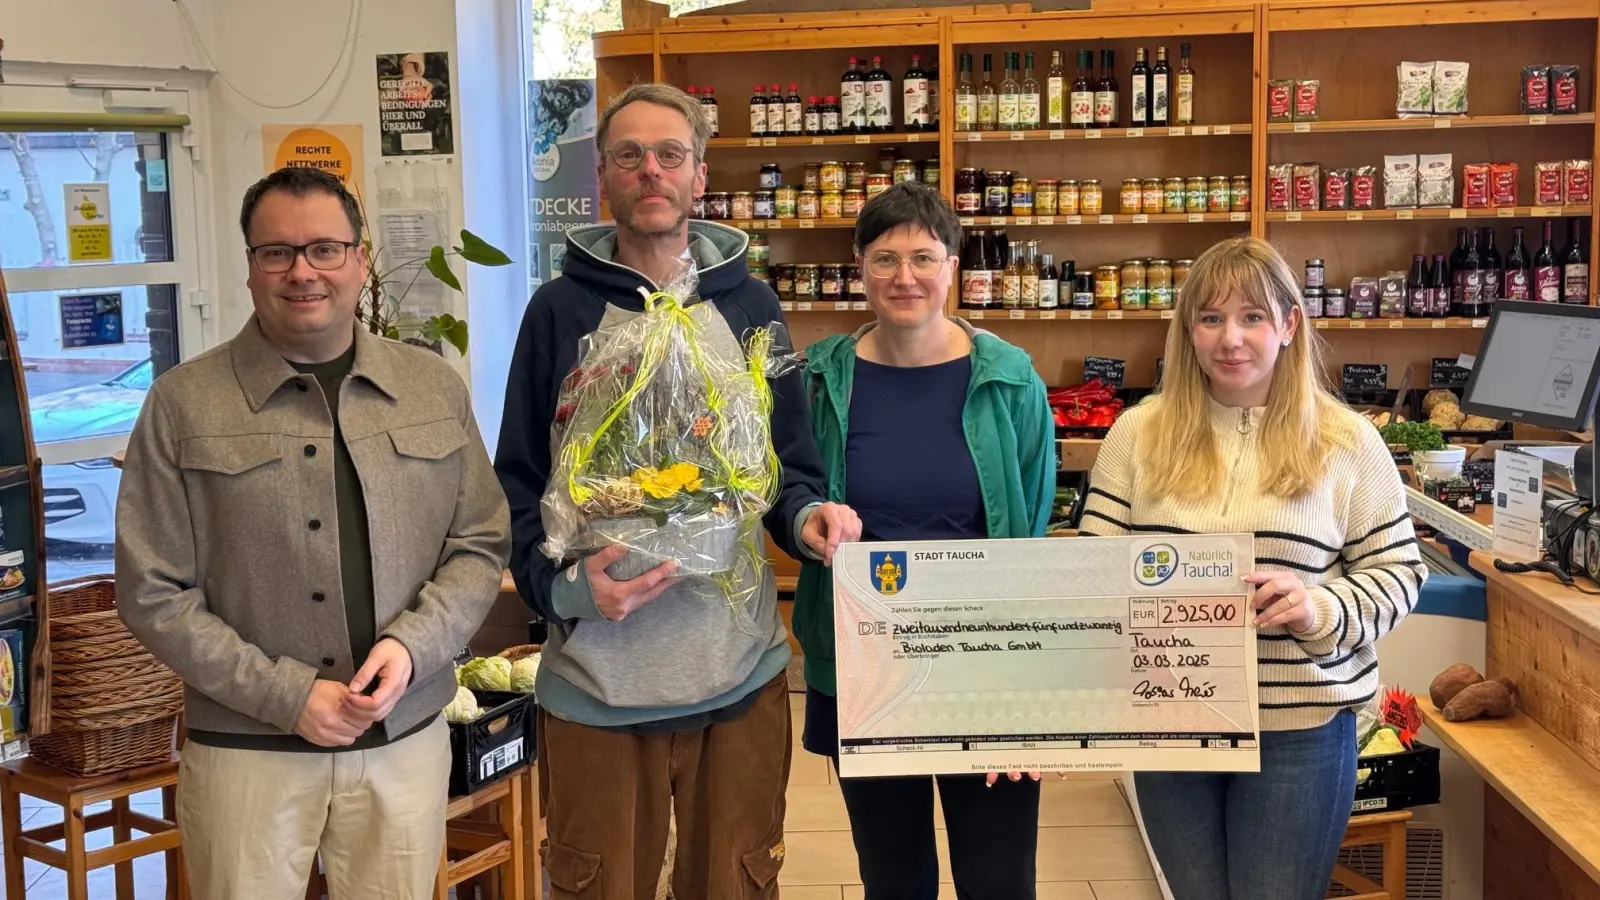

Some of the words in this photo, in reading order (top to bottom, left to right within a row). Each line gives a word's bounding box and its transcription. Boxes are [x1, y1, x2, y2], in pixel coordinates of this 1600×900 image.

[381, 90, 421, 99] ARBEITS-
[381, 99, 447, 110] BEDINGUNGEN
[382, 111, 404, 120] HIER
[405, 111, 426, 120] UND
[382, 120, 424, 131] ÜBERALL
[295, 146, 331, 154] RECHTE
[286, 161, 341, 169] NETZWERKE
[914, 552, 944, 561] STADT
[946, 551, 985, 560] TAUCHA
[1188, 550, 1233, 561] Natürlich
[1181, 561, 1234, 579] Taucha!
[923, 606, 942, 615] gegen
[943, 604, 963, 612] diesen
[964, 604, 984, 612] Scheck
[1133, 610, 1155, 620] EUR
[1161, 604, 1237, 624] 2.925,00
[858, 620, 887, 635] DE
[1128, 632, 1196, 648] Taucha
[900, 641, 955, 654] Bioladen
[957, 641, 1004, 653] Taucha
[1007, 640, 1043, 651] GmbH
[907, 652, 940, 661] Überbringer
[1133, 654, 1211, 668] 03.03.2025
[1039, 761, 1074, 769] beschriften
[1087, 761, 1123, 769] bestempeln
[1362, 799, 1379, 807] IFCO
